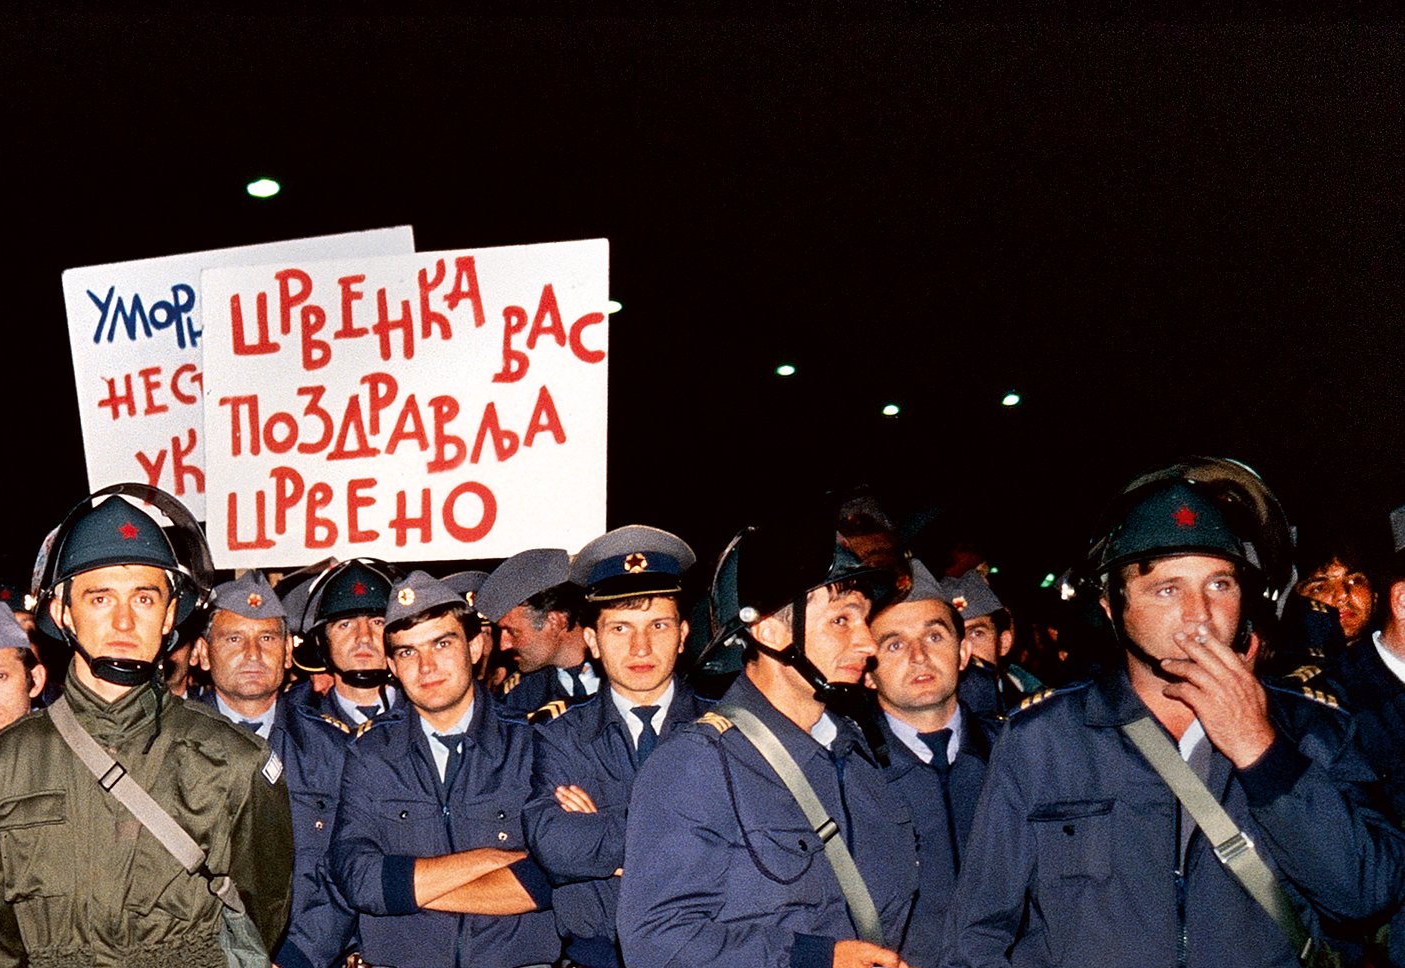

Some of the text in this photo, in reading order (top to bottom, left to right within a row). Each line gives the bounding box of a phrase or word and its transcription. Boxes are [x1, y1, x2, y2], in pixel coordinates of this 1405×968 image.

[230, 255, 606, 383] ЦРВЕНКА ВАС
[227, 466, 497, 551] ЦРВЕНО
